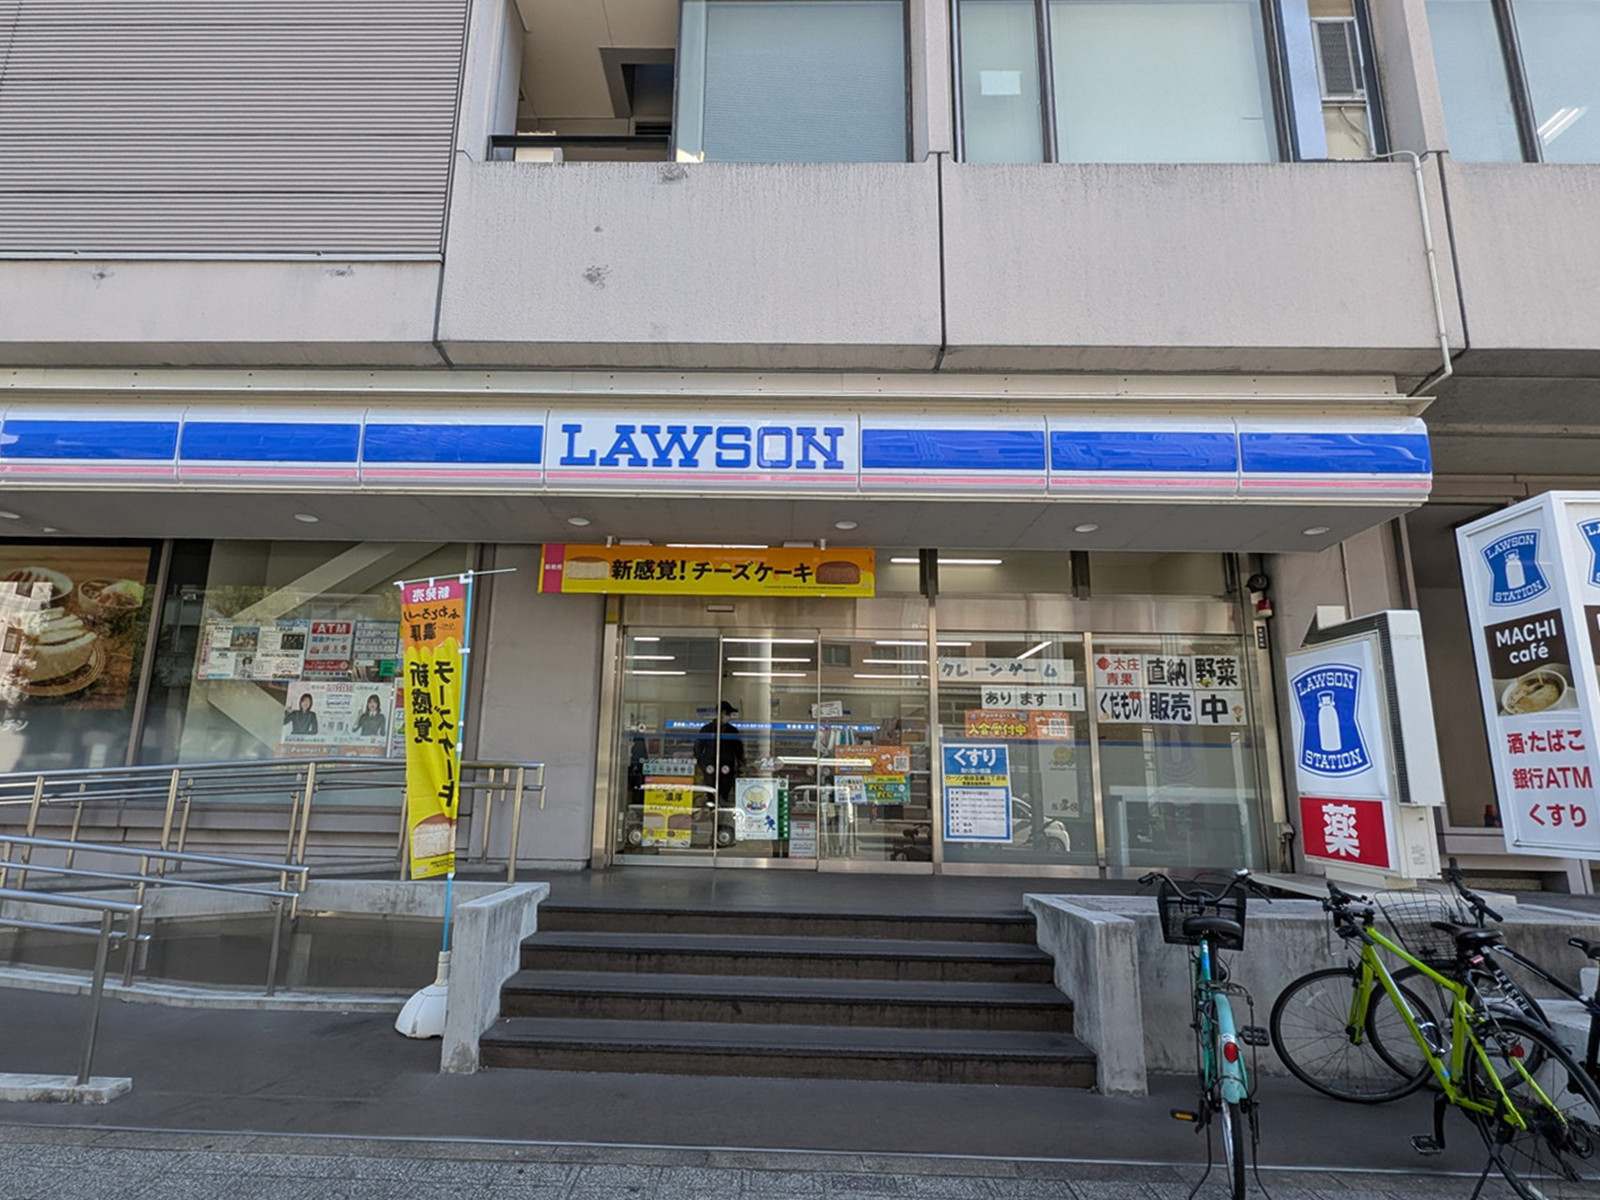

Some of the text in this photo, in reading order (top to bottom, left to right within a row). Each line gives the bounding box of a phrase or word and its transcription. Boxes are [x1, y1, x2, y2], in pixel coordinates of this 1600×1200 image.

[559, 423, 844, 469] LAWSON
[1486, 534, 1535, 559] LAWSON
[1495, 580, 1543, 602] STATION
[316, 623, 348, 634] ATM
[1495, 618, 1557, 648] MACHI
[1509, 642, 1549, 664] café
[942, 662, 1058, 677] クレーンゲーム
[1106, 672, 1134, 686] 青果
[1297, 672, 1354, 696] LAWSON
[760, 757, 775, 767] 24
[953, 748, 997, 767] くすり
[1305, 748, 1364, 770] STATION
[1512, 766, 1593, 790] 銀行ATM
[1529, 803, 1587, 827] くすり
[1322, 803, 1360, 858] 薬
